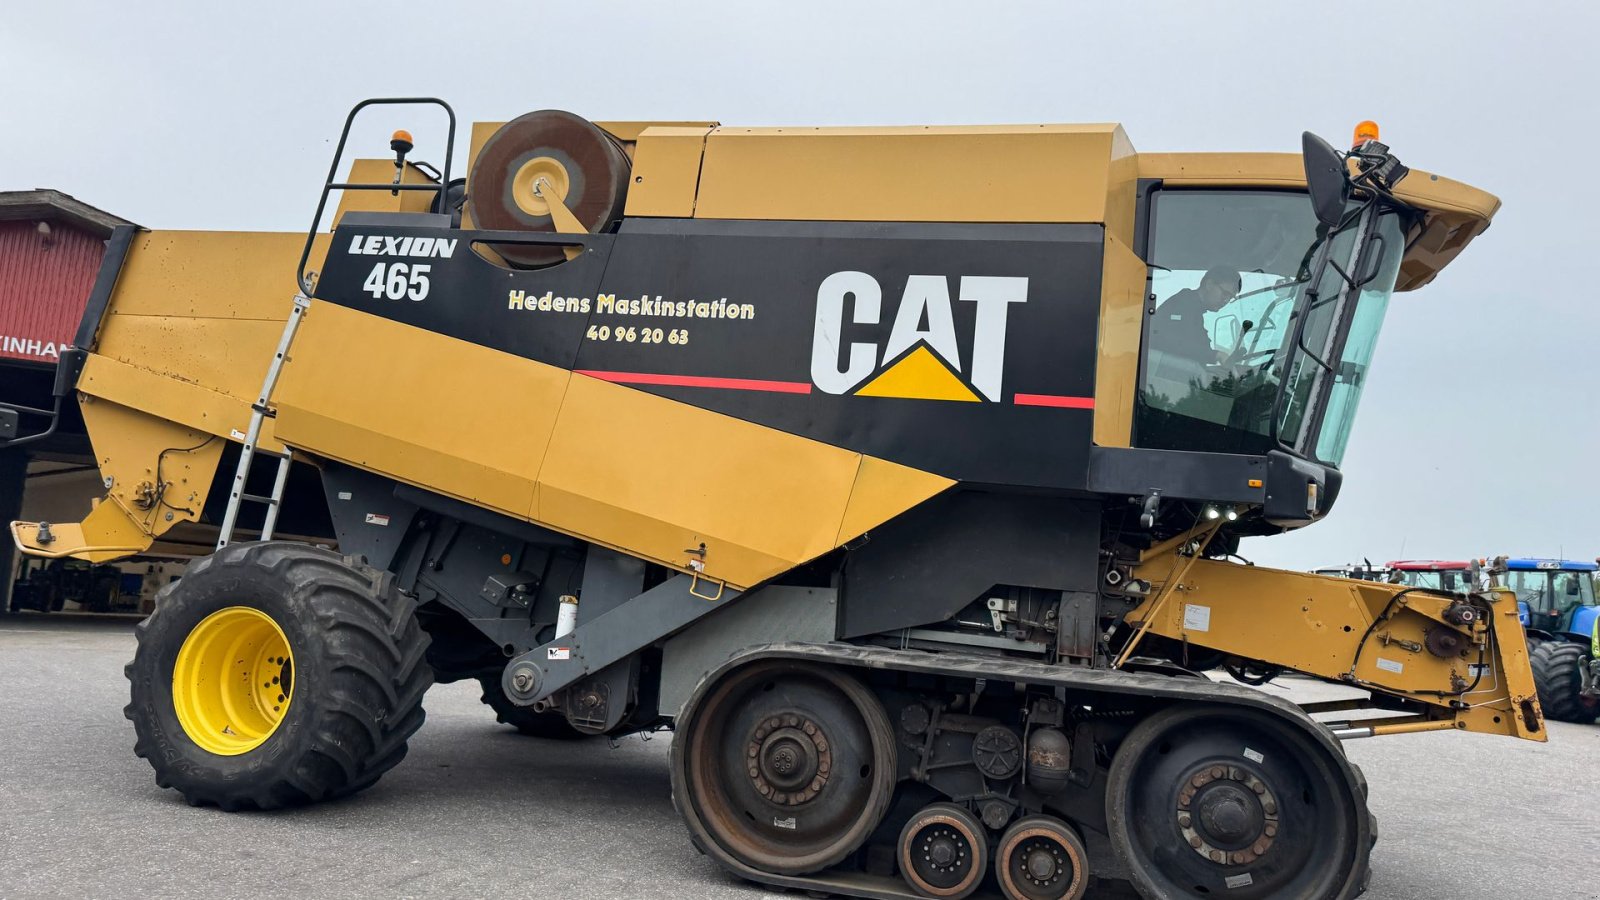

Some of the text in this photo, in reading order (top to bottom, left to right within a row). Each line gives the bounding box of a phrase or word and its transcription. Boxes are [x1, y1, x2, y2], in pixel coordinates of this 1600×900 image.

[348, 235, 458, 258] LEXION
[363, 262, 431, 301] 465
[508, 289, 755, 320] Hedens Maskinstation
[0, 336, 74, 358] INHA
[586, 325, 689, 345] 40 96 20 63
[811, 271, 1029, 402] CAT
